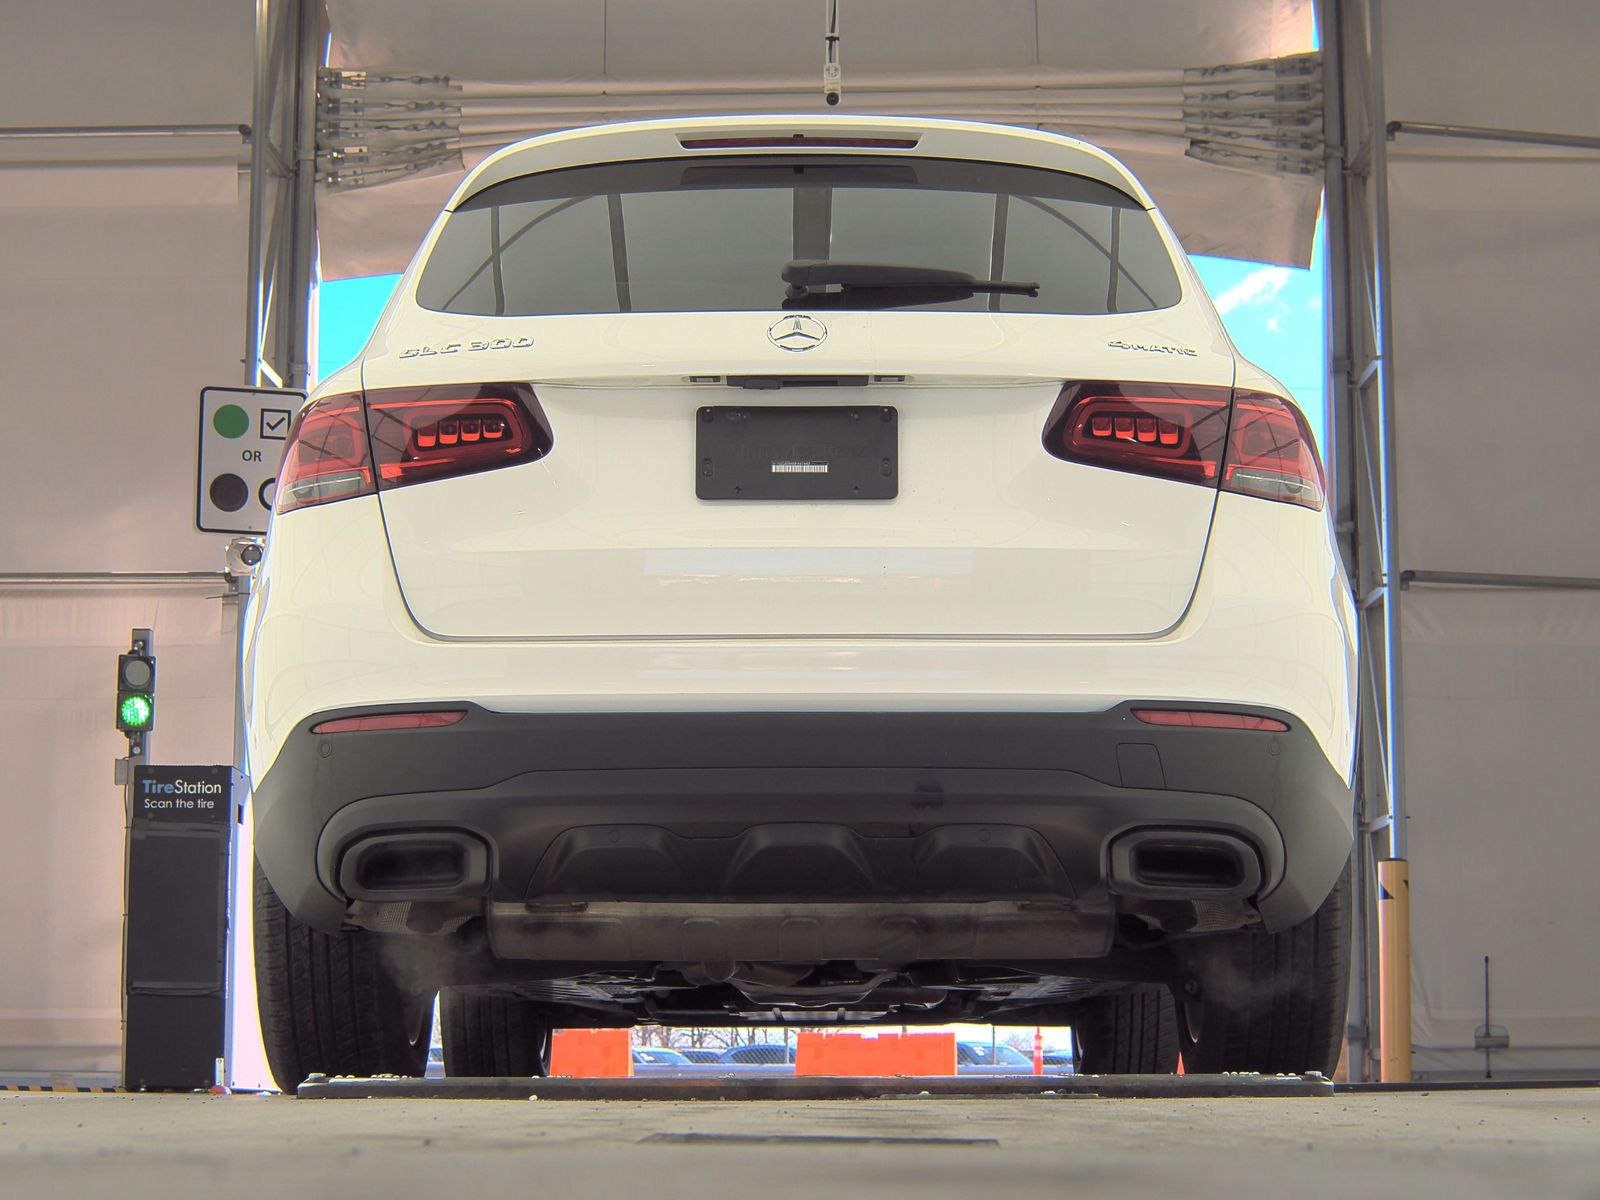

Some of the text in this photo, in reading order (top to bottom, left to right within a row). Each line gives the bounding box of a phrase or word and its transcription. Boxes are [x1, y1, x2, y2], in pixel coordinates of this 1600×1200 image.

[399, 337, 535, 359] GLC 300
[1107, 340, 1198, 357] 4MATIC
[241, 450, 262, 462] OR
[142, 779, 222, 794] TireStation
[144, 799, 215, 809] Scan the tire
